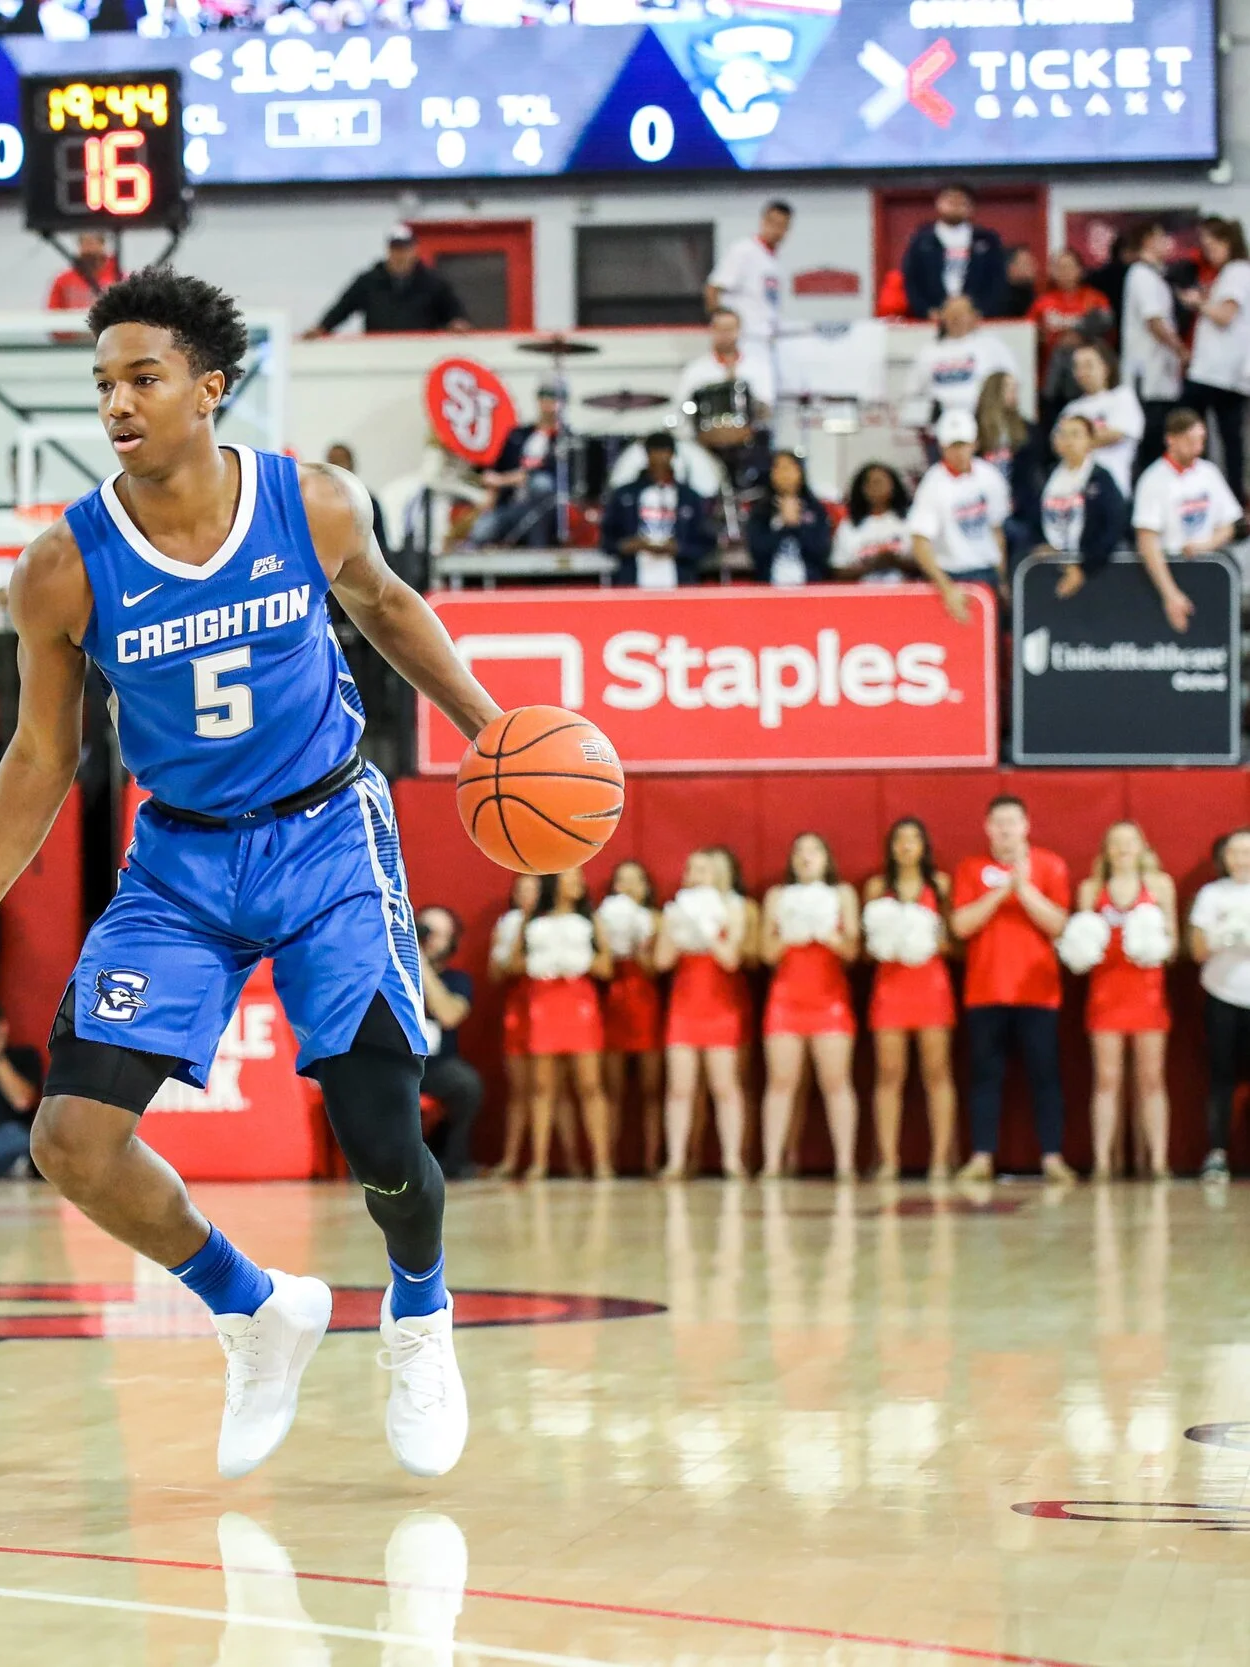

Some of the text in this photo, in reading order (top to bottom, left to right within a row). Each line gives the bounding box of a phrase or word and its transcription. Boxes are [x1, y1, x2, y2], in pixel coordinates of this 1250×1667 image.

[231, 36, 418, 93] 19:44
[968, 46, 1192, 91] TICKET
[48, 83, 168, 132] 19:44
[629, 105, 675, 162] 0
[974, 90, 1186, 120] GALAXY
[84, 130, 152, 215] 16
[251, 560, 285, 577] EAST
[253, 554, 277, 568] BIG
[116, 584, 311, 664] CREIGHTON
[190, 646, 254, 739] 5
[602, 628, 951, 729] Staples
